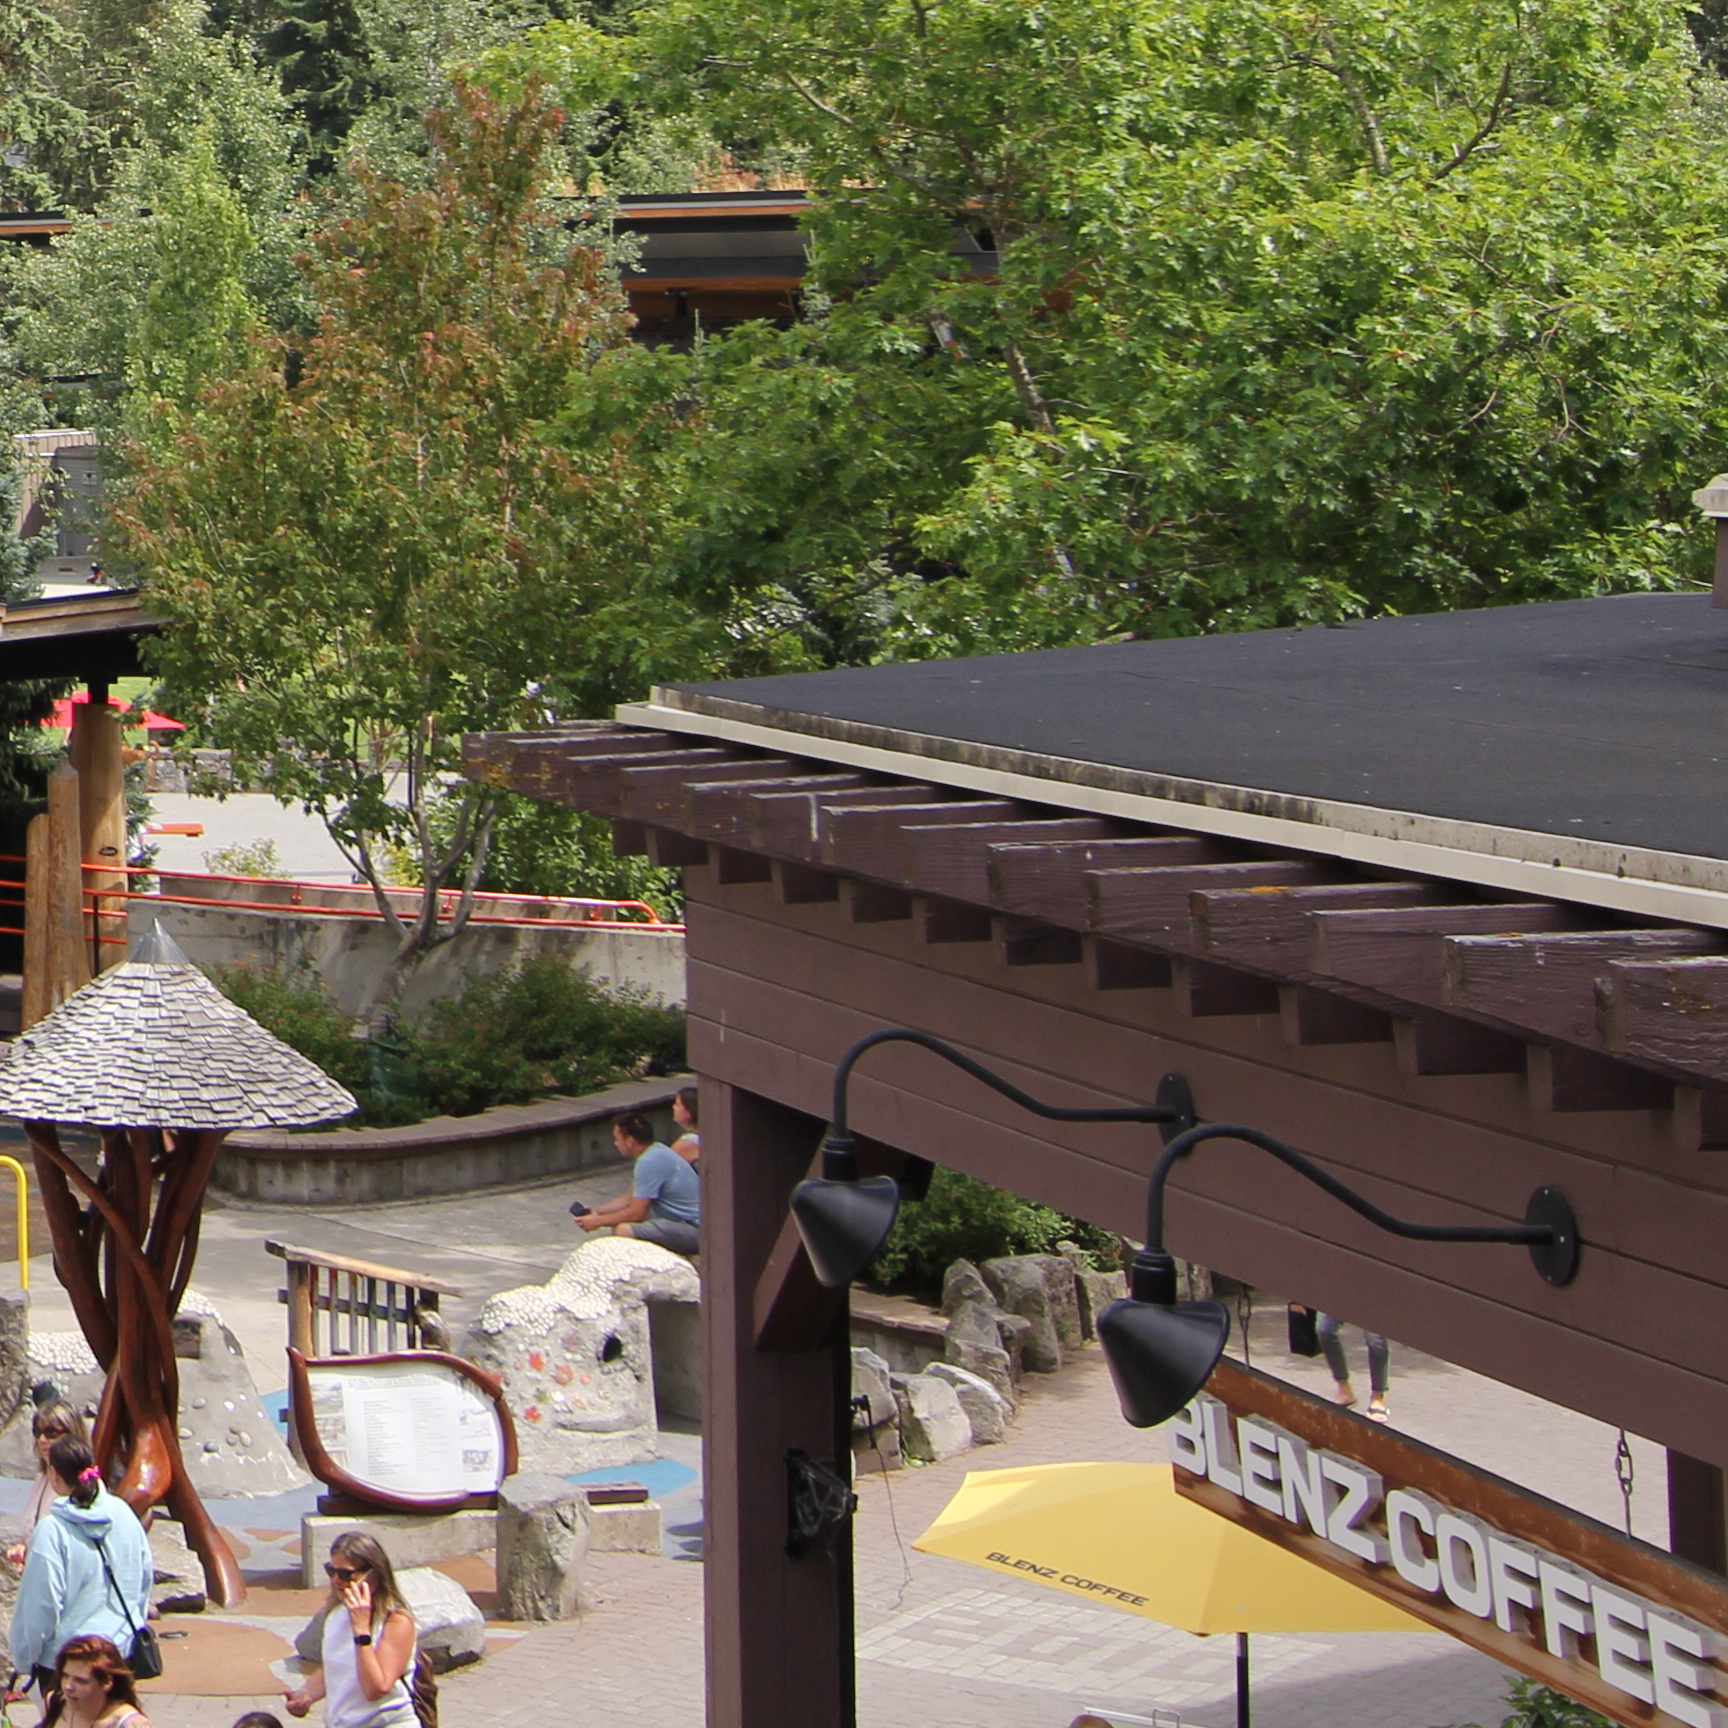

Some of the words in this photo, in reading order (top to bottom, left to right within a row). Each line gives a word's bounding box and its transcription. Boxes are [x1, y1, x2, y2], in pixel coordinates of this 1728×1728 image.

[985, 1551, 1059, 1579] BLENZ
[1059, 1574, 1149, 1607] COFFEE
[1166, 1390, 1390, 1564] BLENZ
[1385, 1486, 1728, 1728] COFFEE
